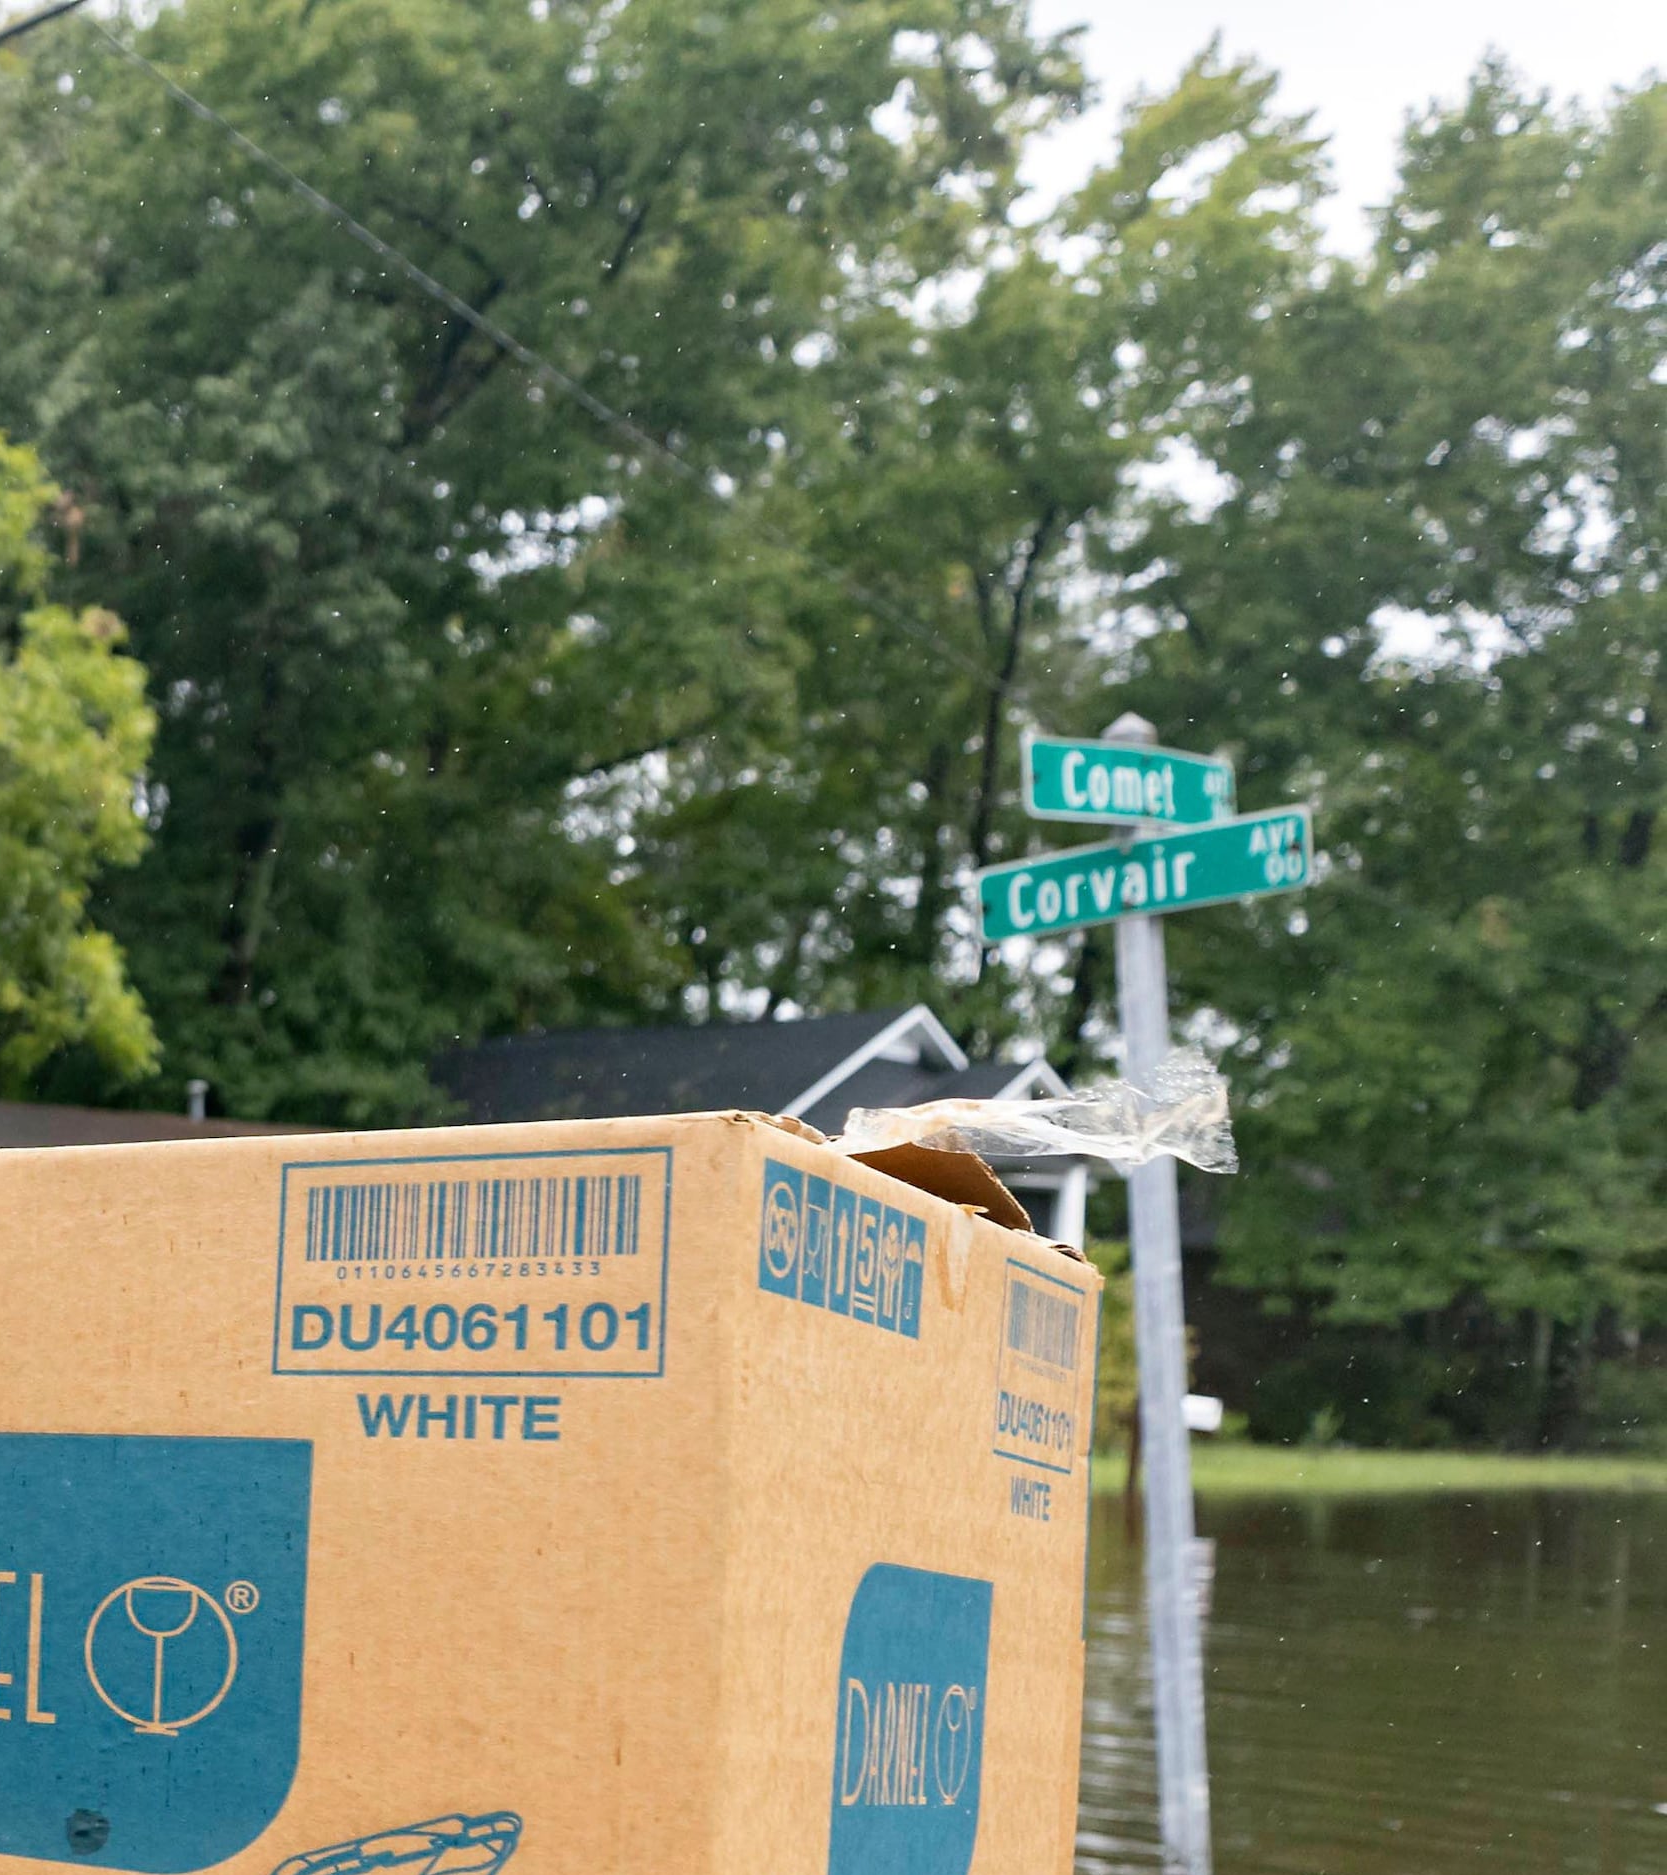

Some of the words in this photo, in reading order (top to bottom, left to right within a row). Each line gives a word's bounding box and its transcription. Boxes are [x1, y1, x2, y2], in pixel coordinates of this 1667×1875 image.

[1061, 750, 1175, 818] Comet
[1007, 844, 1196, 929] Corvair
[291, 1302, 651, 1352] DU4061101
[356, 1394, 561, 1441] WHITE
[1011, 1475, 1050, 1521] WHITE
[840, 1677, 930, 1806] DARNEL
